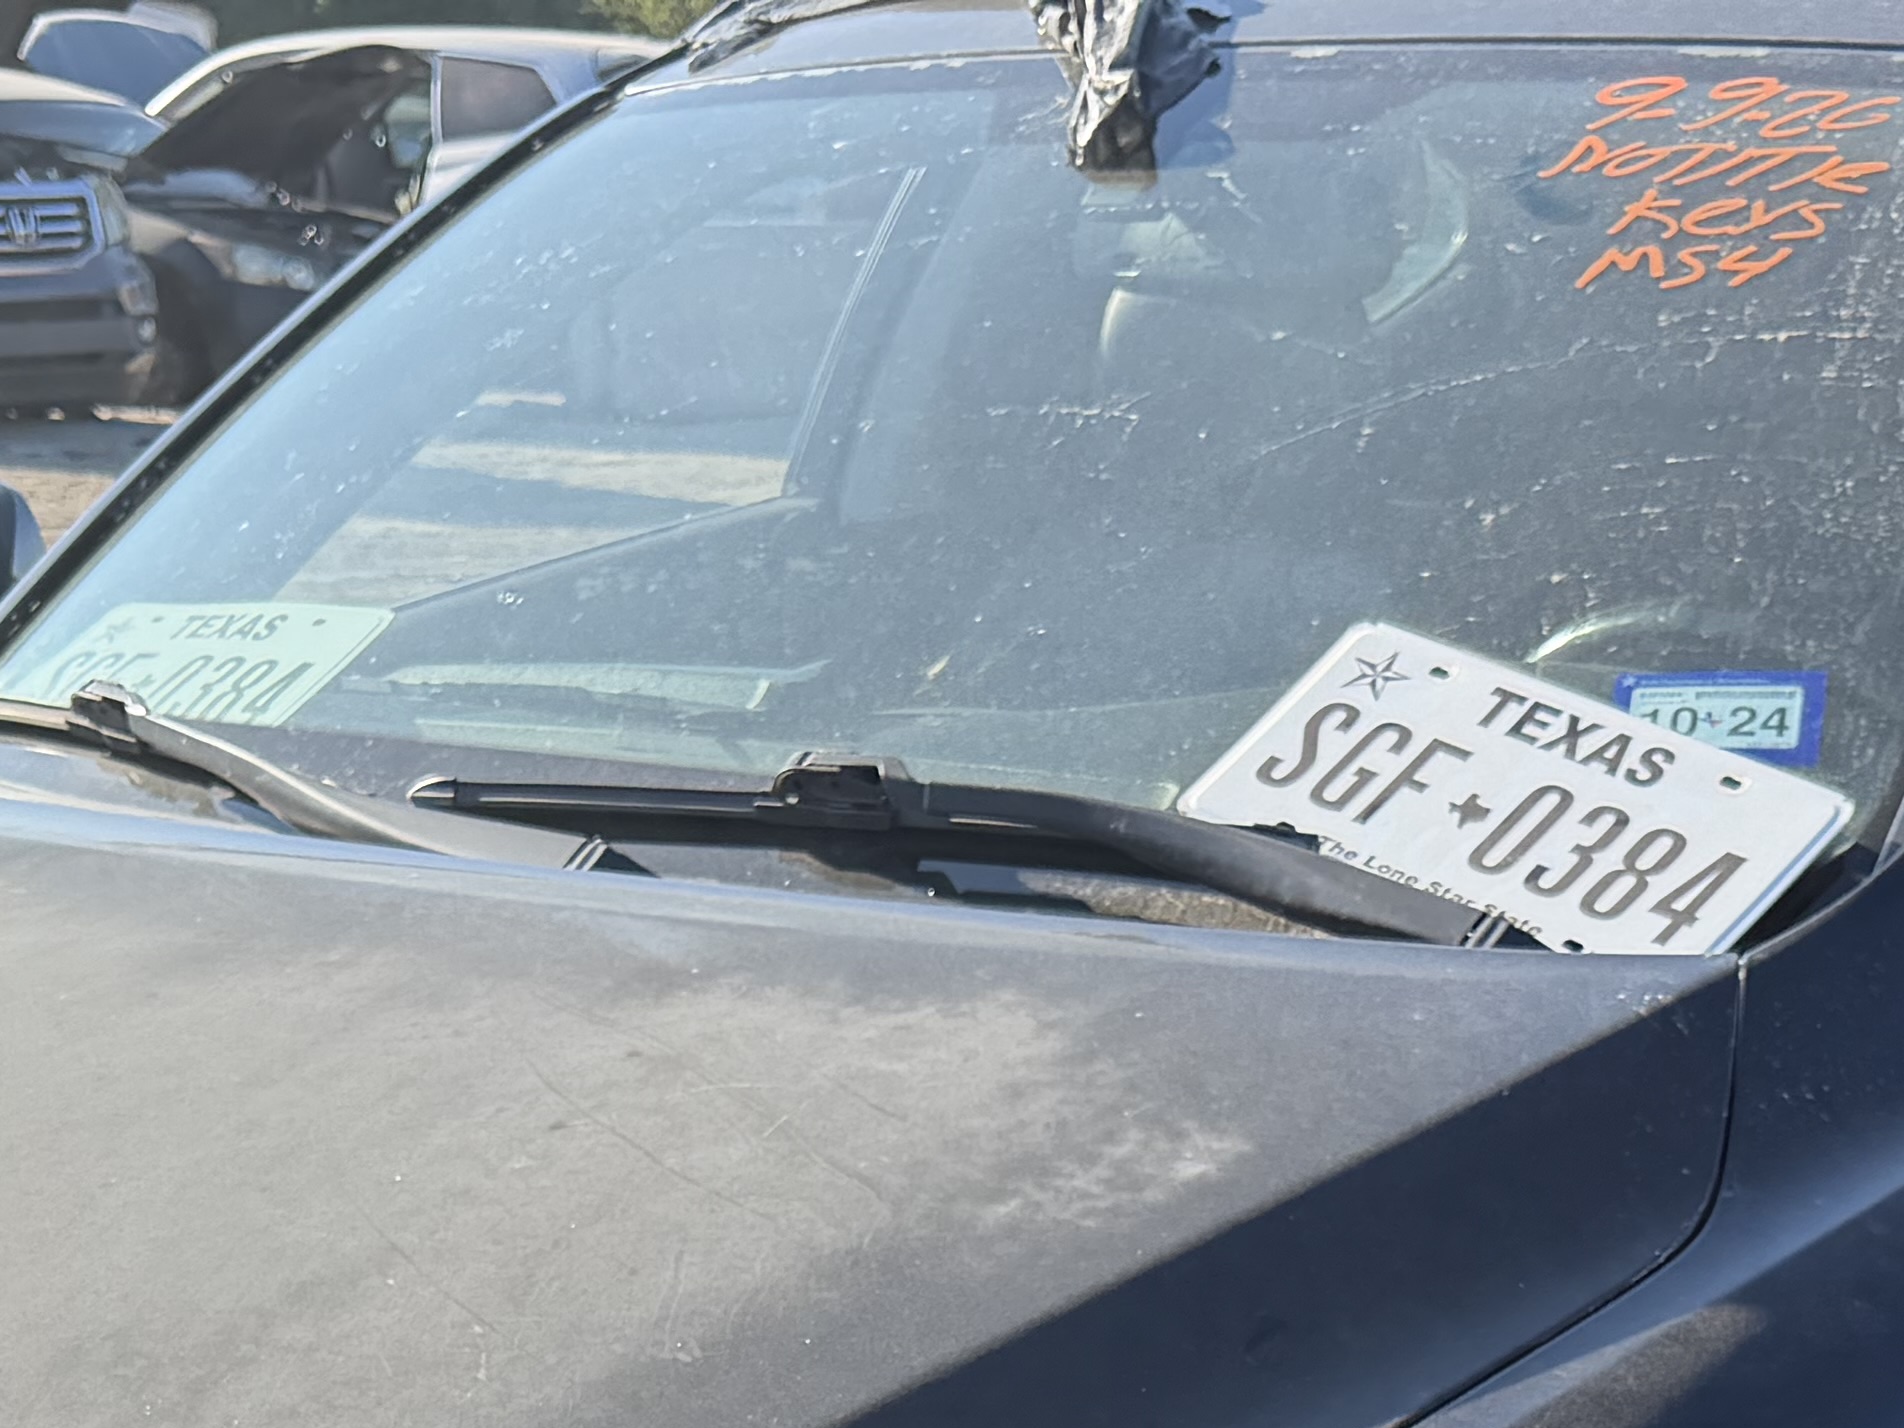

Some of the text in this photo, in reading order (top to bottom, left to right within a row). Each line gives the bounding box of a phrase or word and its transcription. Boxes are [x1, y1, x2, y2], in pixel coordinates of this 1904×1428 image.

[169, 613, 289, 641] TEXAS
[1476, 685, 1677, 789] TEXAS
[1726, 705, 1790, 738] 24
[1254, 701, 1750, 948] SGF 0384
[1319, 834, 1358, 860] The
[1363, 855, 1419, 886] Lone
